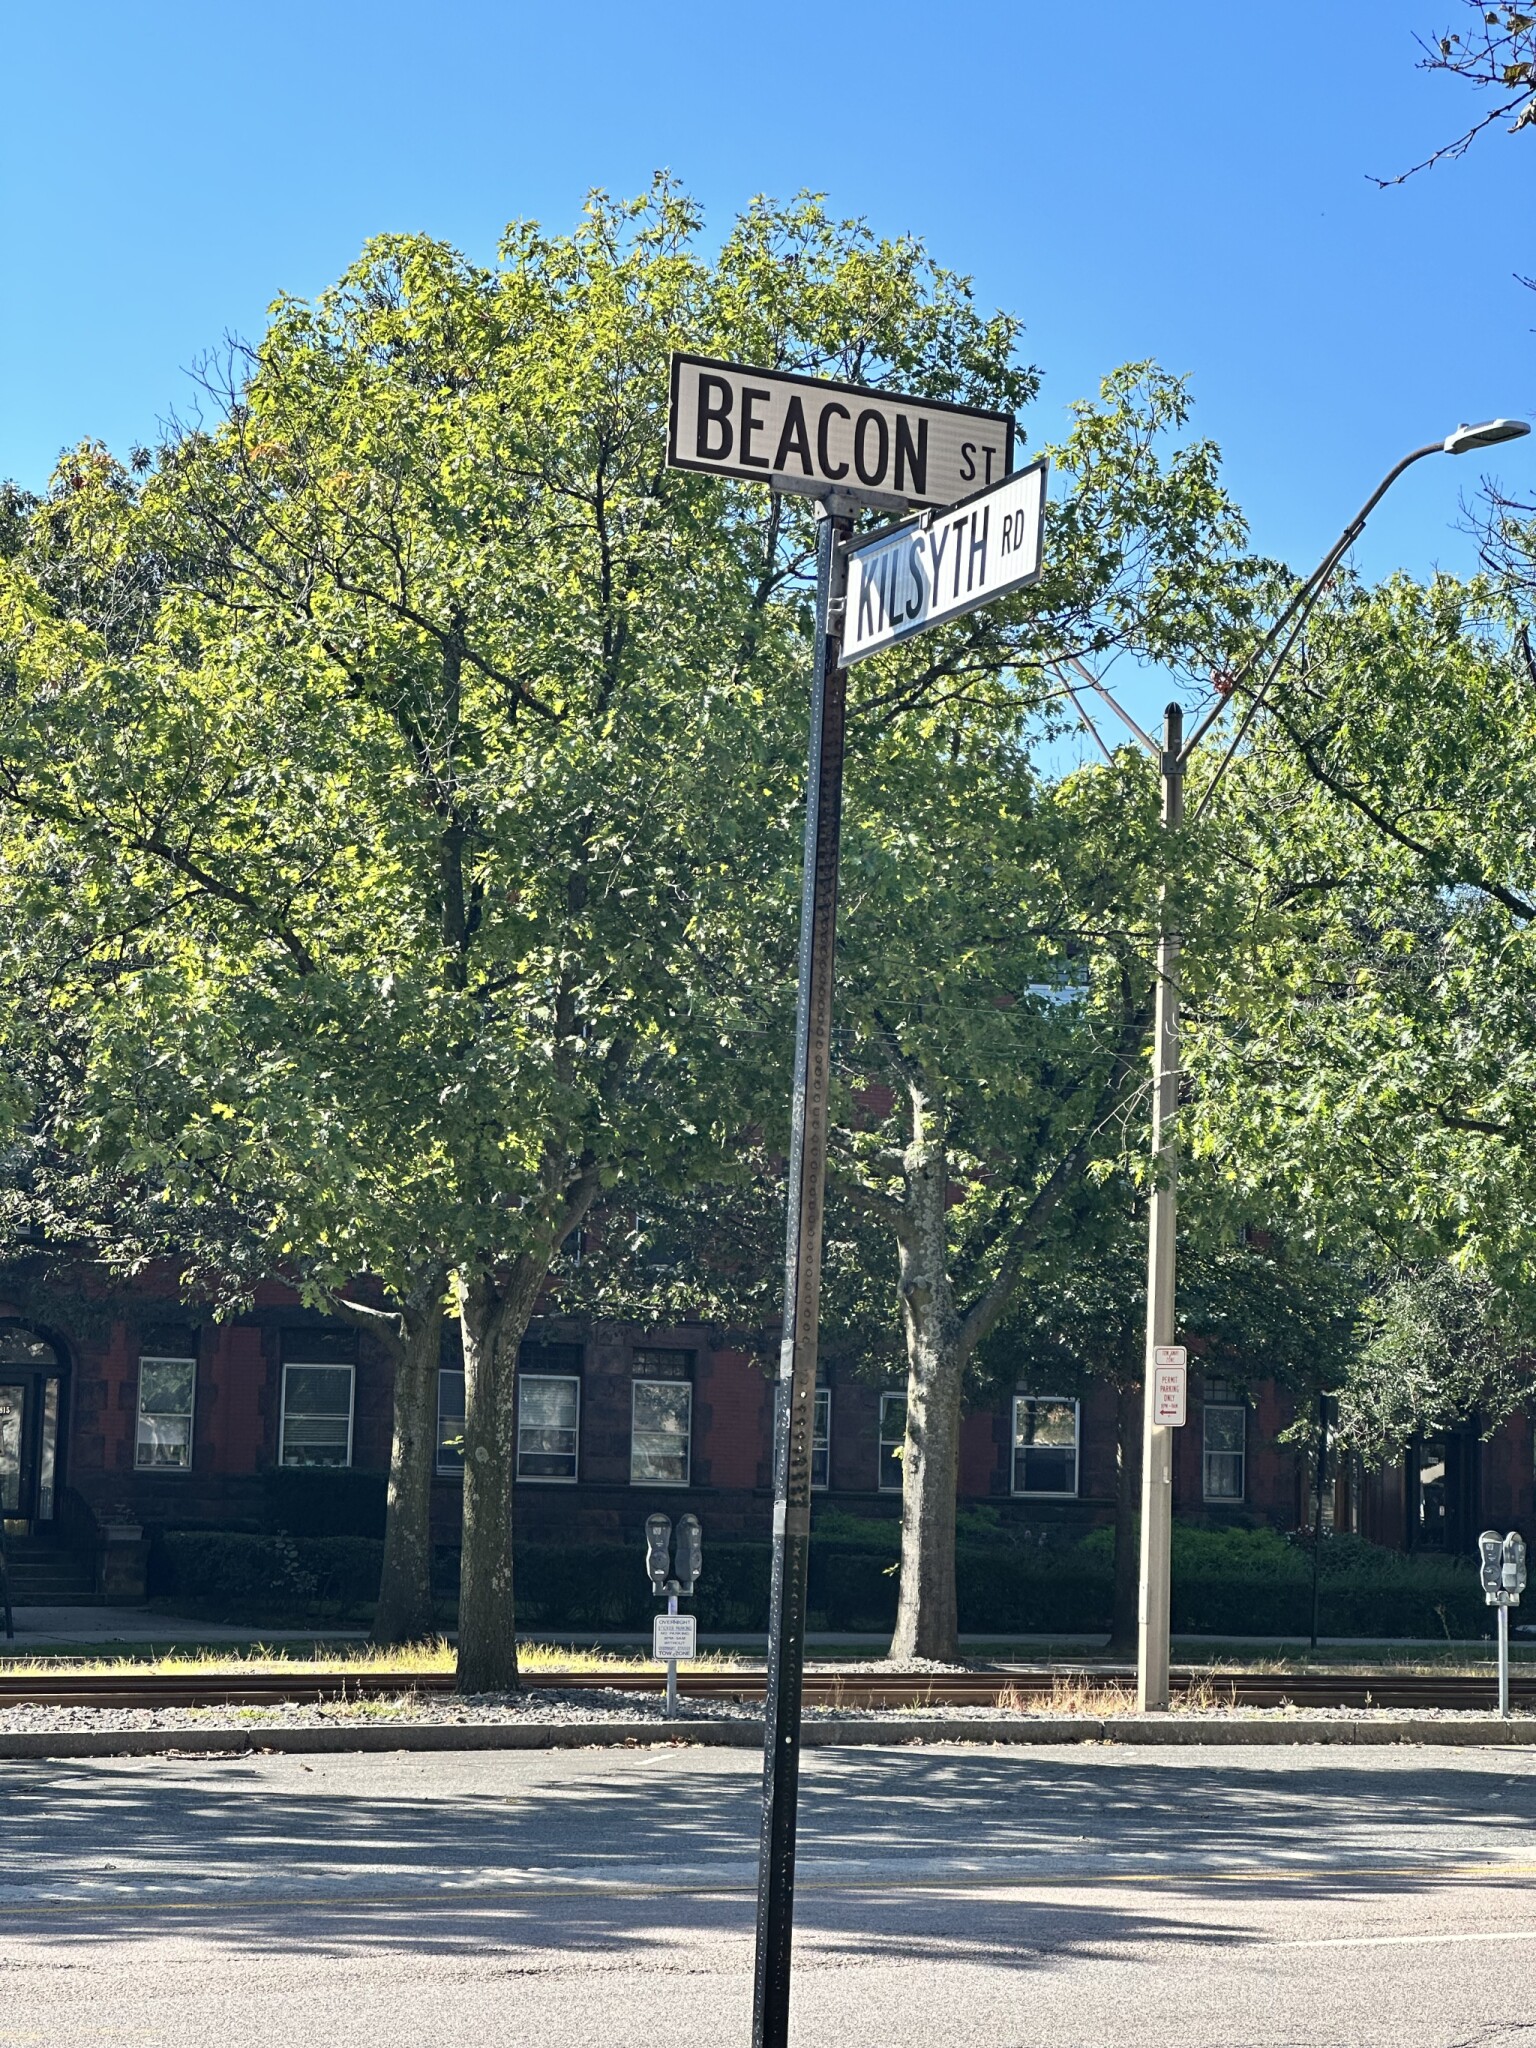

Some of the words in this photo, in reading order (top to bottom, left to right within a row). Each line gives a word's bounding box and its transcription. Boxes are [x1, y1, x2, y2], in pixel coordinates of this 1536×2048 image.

[696, 373, 929, 495] BEACON
[959, 442, 997, 485] ST
[857, 504, 990, 642] KILSYTH
[1001, 508, 1025, 557] RD
[1161, 1376, 1178, 1384] PERMIT
[1160, 1385, 1179, 1393] PARKING
[1163, 1394, 1175, 1402] ONLY
